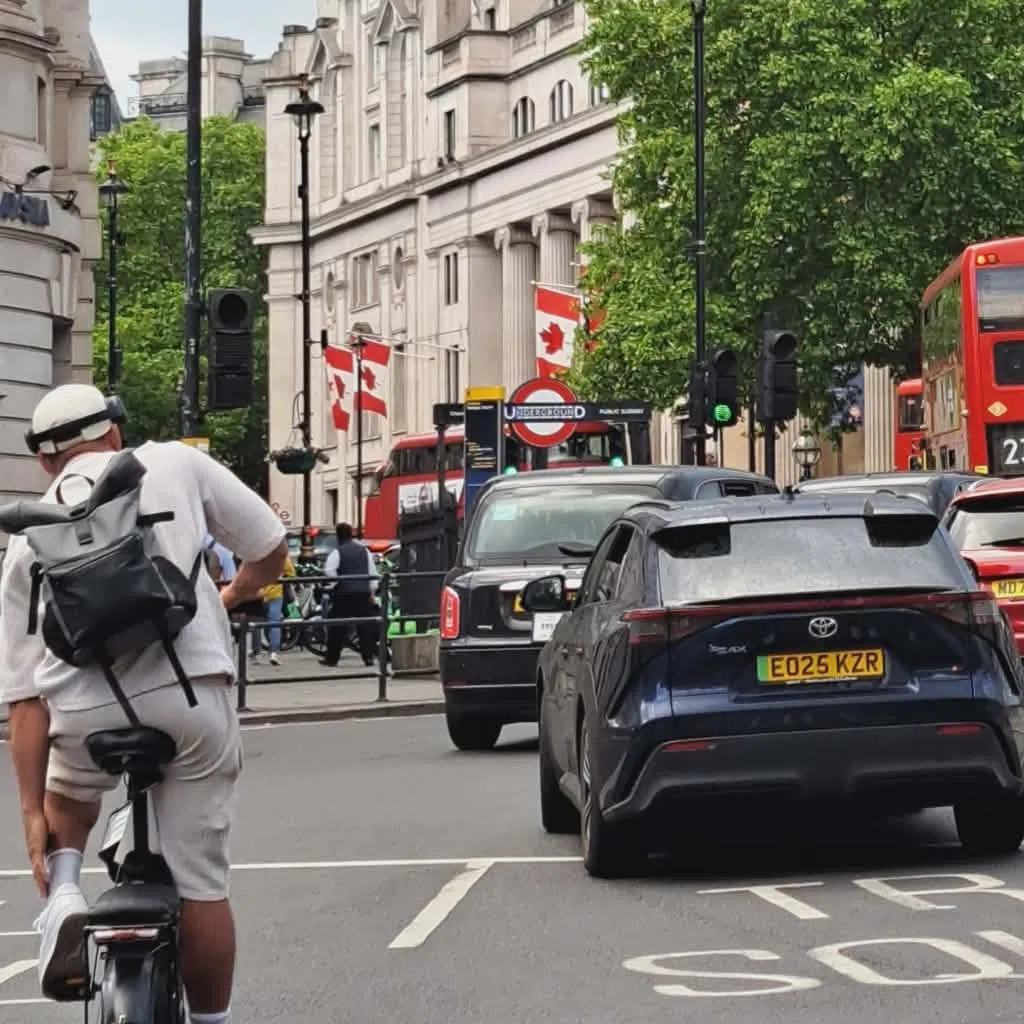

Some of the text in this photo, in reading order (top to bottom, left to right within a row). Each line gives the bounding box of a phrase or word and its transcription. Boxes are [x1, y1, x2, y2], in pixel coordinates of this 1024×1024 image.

[504, 406, 586, 419] UNDERGROUND
[771, 652, 879, 677] EO25 KZR
